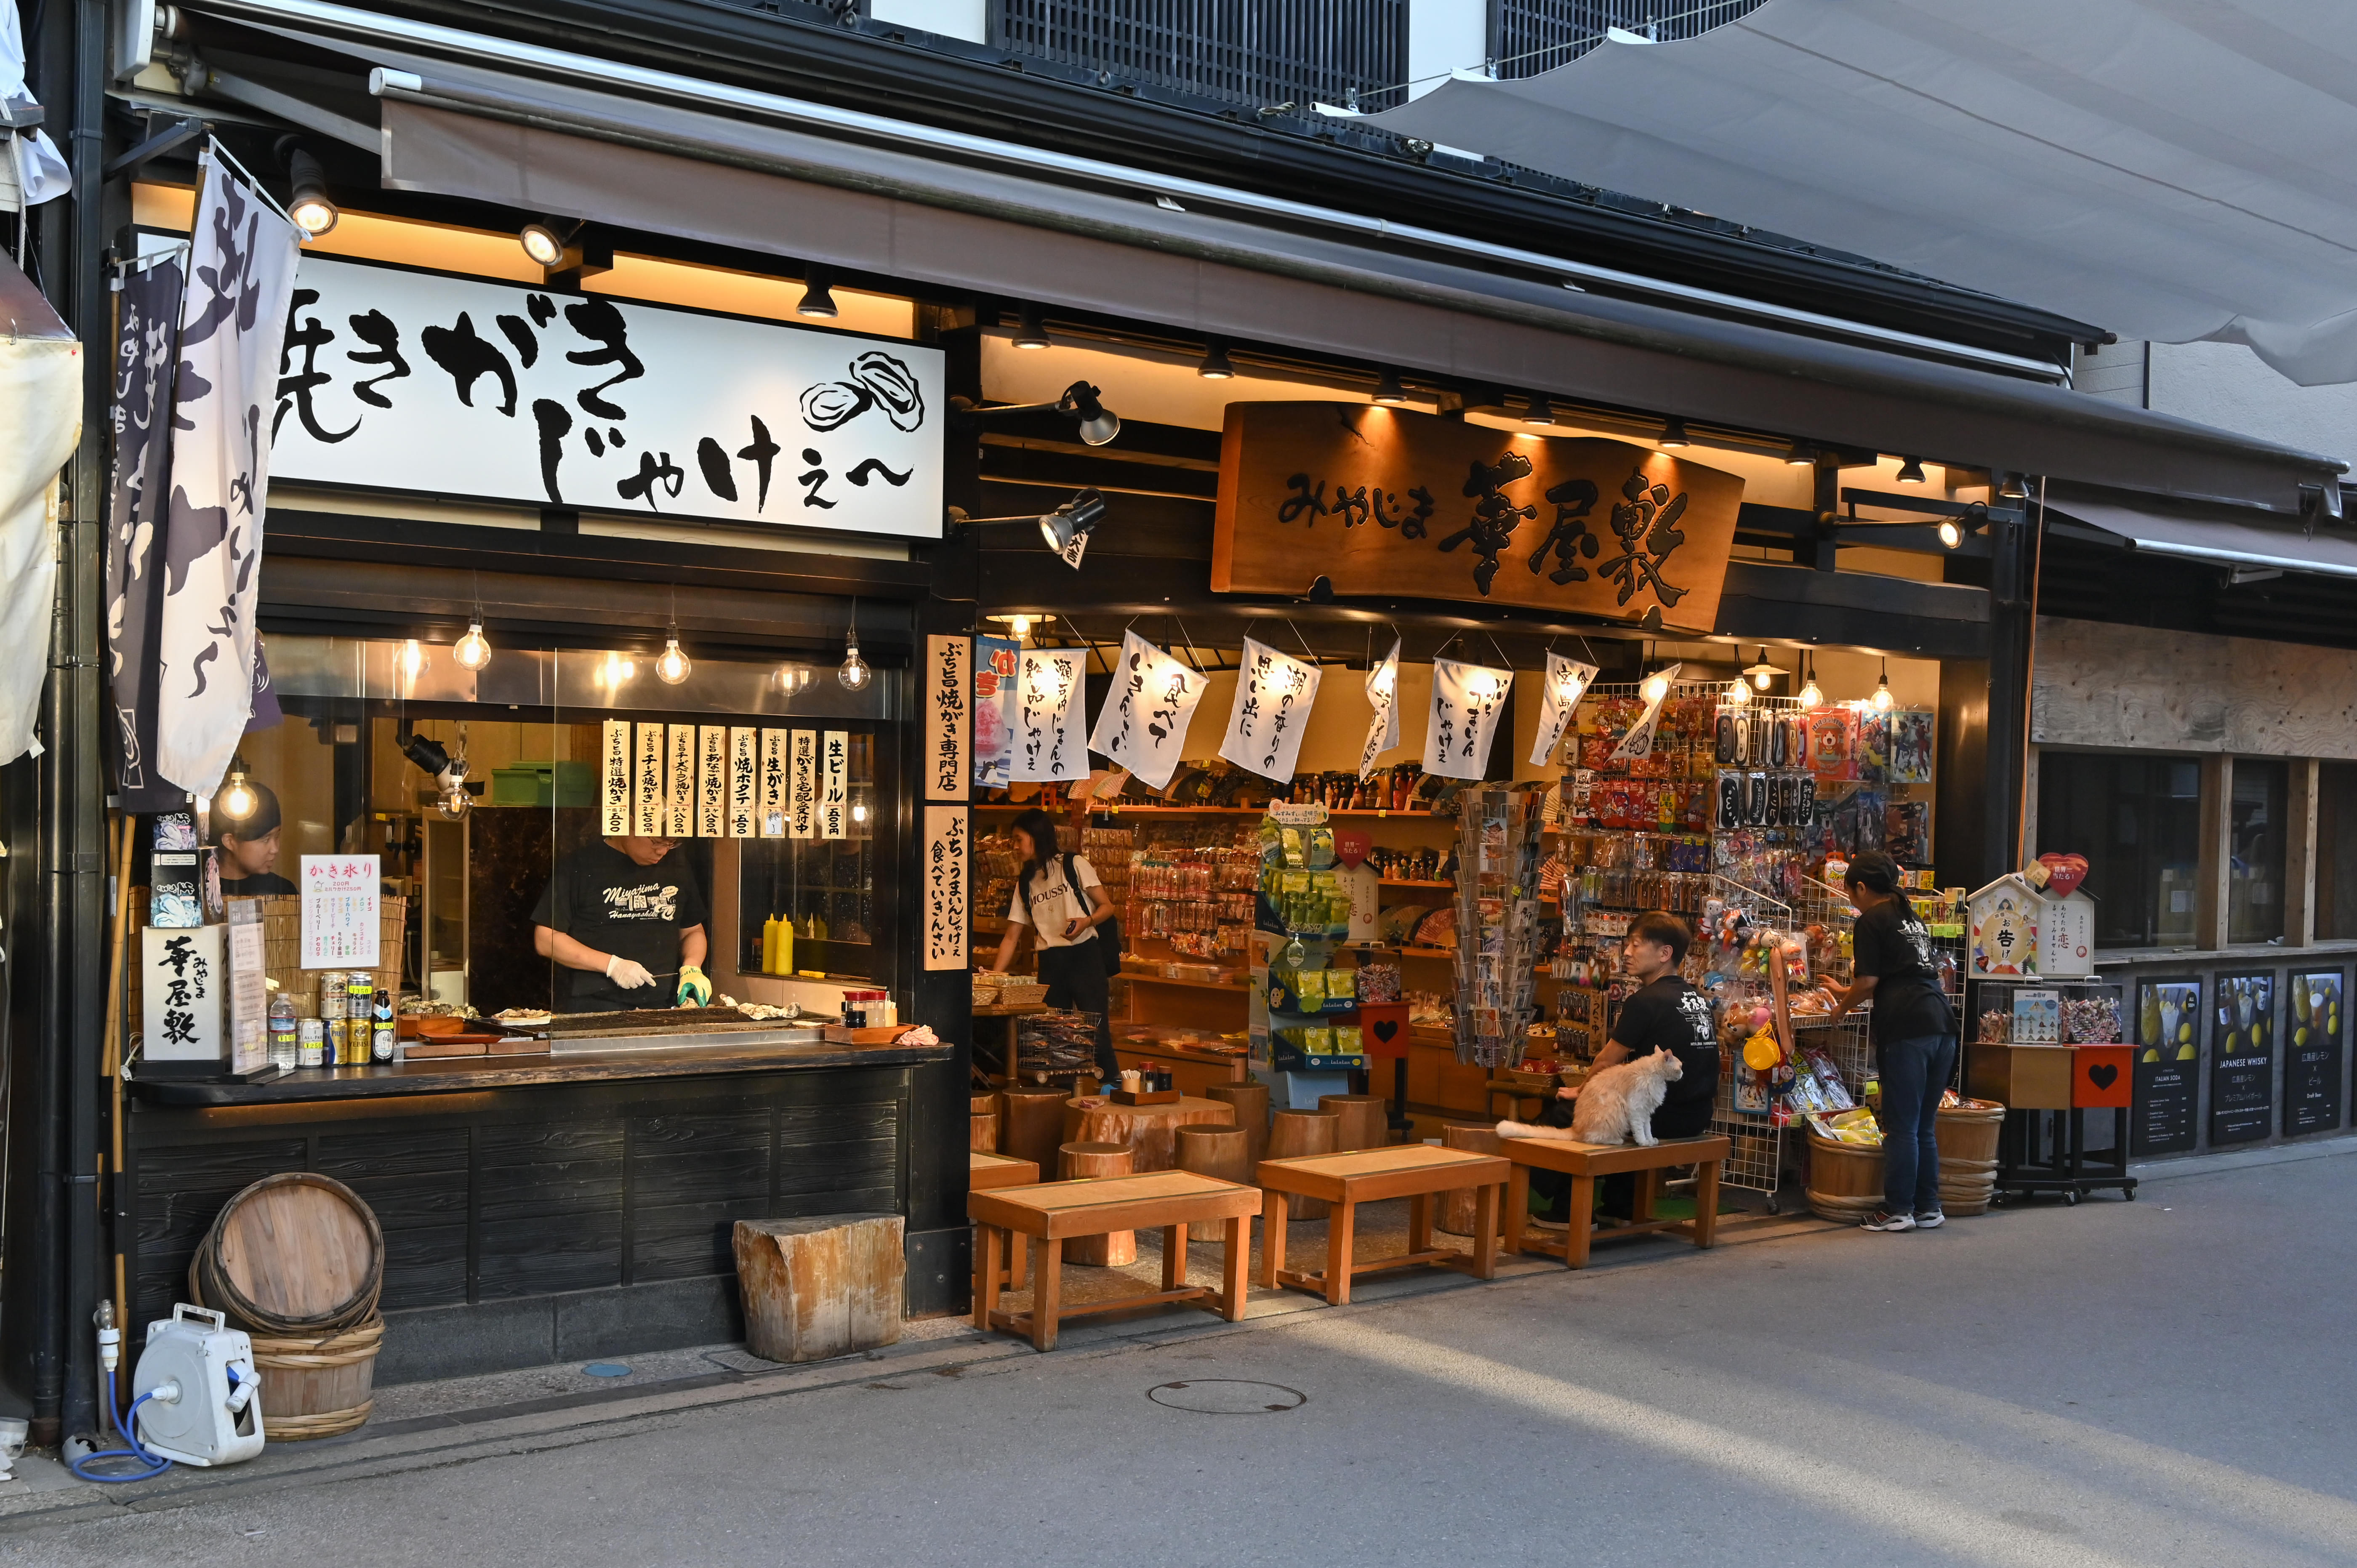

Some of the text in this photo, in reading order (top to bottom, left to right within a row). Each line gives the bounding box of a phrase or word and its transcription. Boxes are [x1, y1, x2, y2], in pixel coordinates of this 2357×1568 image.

[1277, 450, 1690, 608] みやじま 華屋敷
[936, 642, 964, 791] ぶち旨焼がき専門店
[608, 729, 627, 805] ぶち旨特選焼がき
[734, 734, 753, 805] ぶち旨焼ホタテ
[766, 735, 784, 805] ぶち旨生がき
[828, 740, 844, 803] 生ビール
[310, 863, 372, 879] かき氷り
[602, 883, 660, 904] Miyajima
[930, 840, 946, 959] 食べていきんさい
[609, 910, 659, 920] Hanayashiki
[1997, 919, 2015, 959] お告げ
[2058, 905, 2069, 949] あなたの恋
[158, 936, 201, 1045] 華屋敷
[193, 957, 208, 999] みやじま
[2220, 1057, 2267, 1069] JAPANESE WHISKY
[2309, 1076, 2322, 1086] ビール
